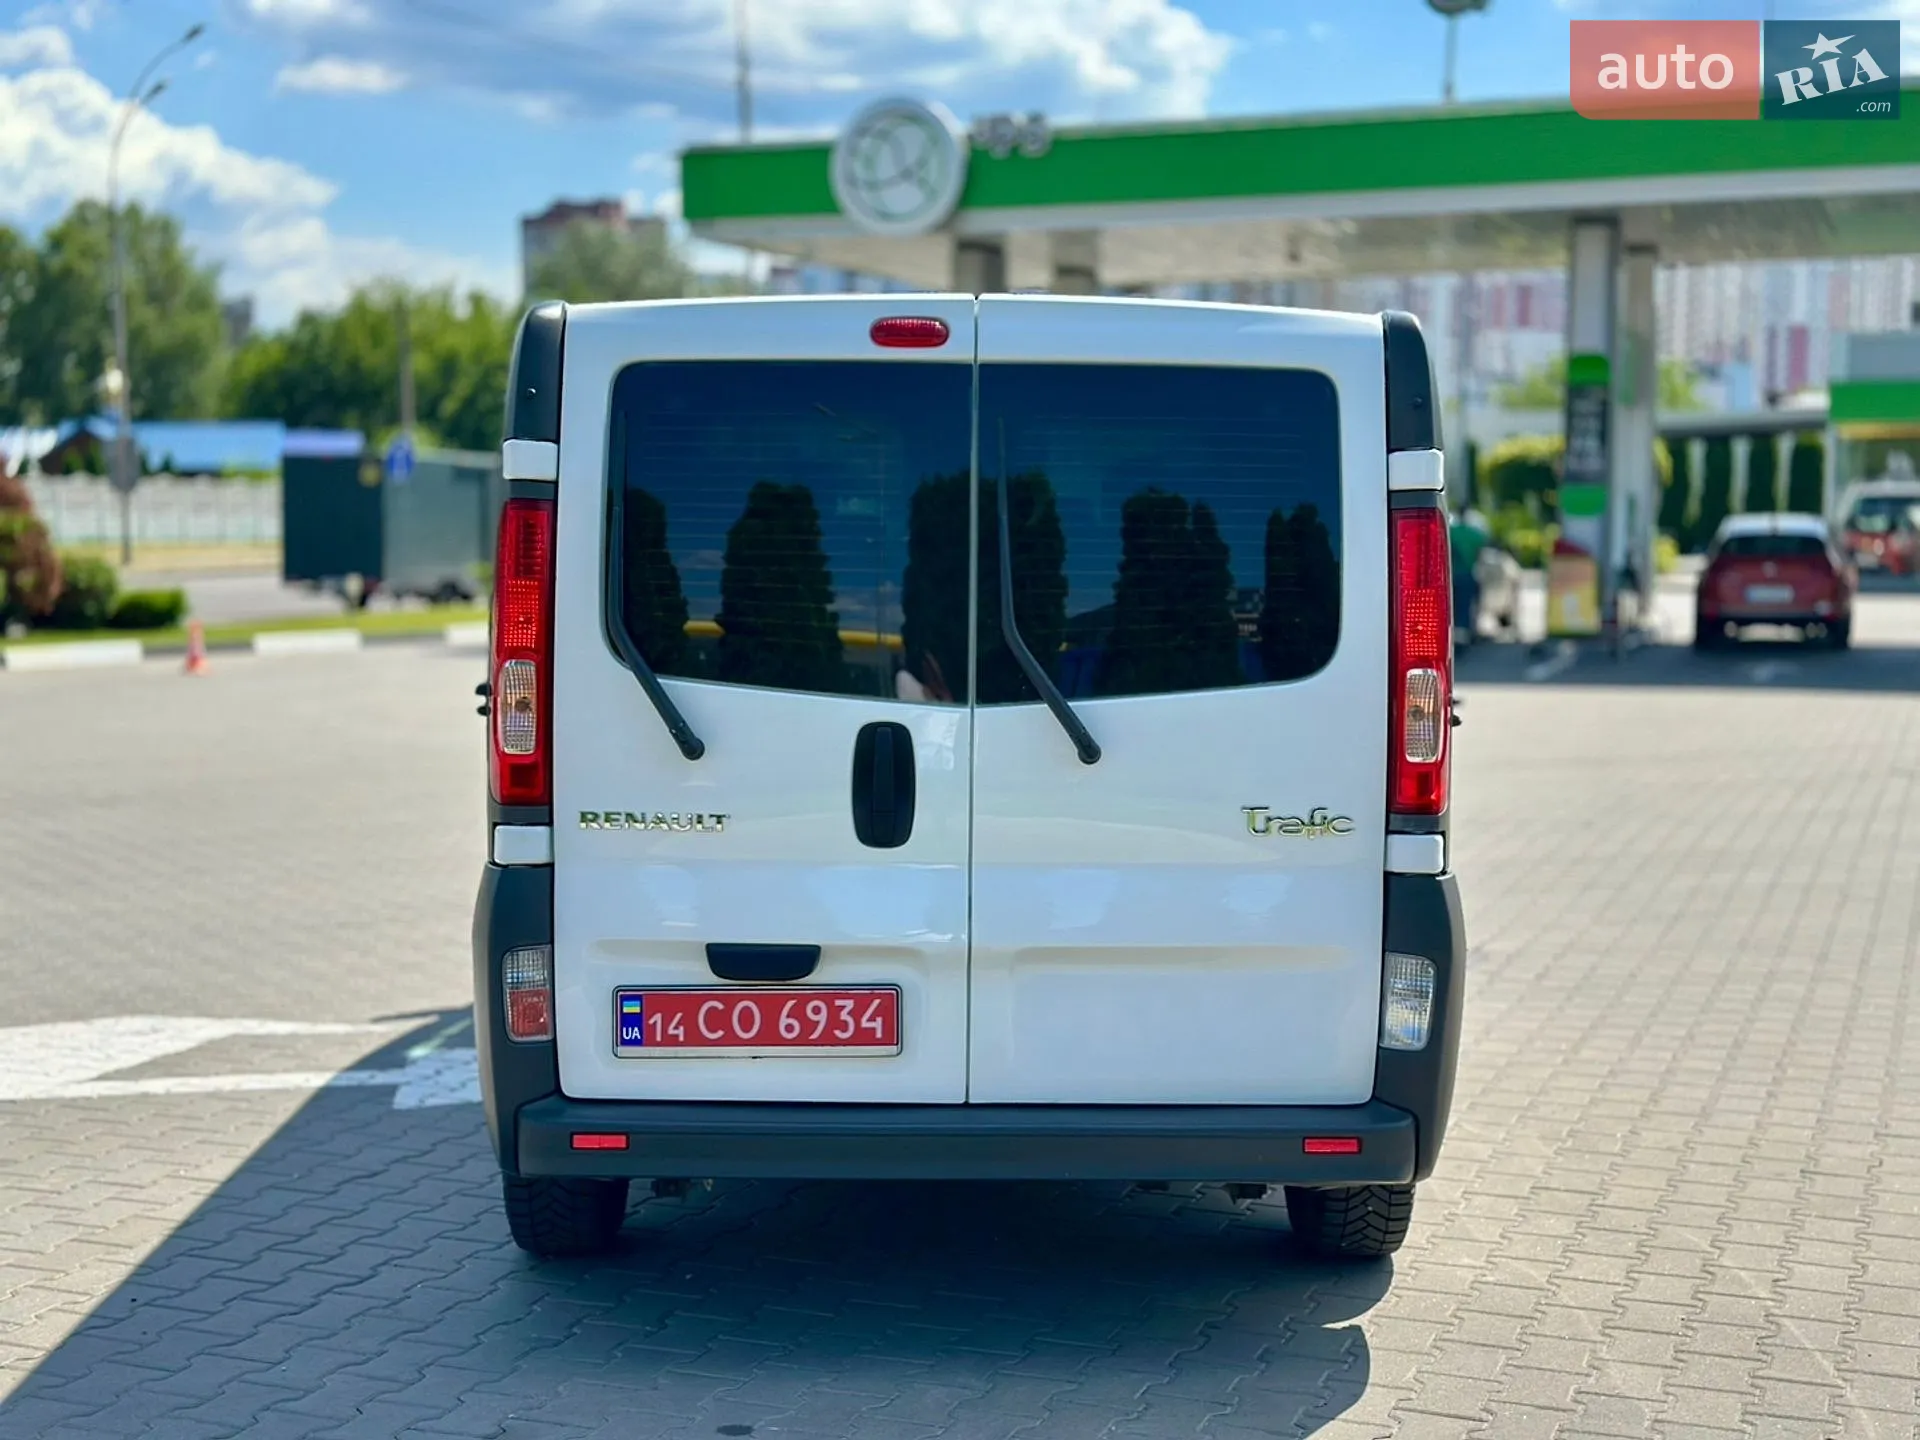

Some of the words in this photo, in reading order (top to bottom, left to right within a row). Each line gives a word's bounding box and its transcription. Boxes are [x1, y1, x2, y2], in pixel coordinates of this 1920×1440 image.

[578, 811, 730, 832] RENAULT
[1241, 806, 1355, 840] Trafic
[622, 1026, 641, 1040] UA
[648, 1012, 684, 1042] 14
[698, 1000, 761, 1040] CO
[778, 998, 883, 1039] 6934
